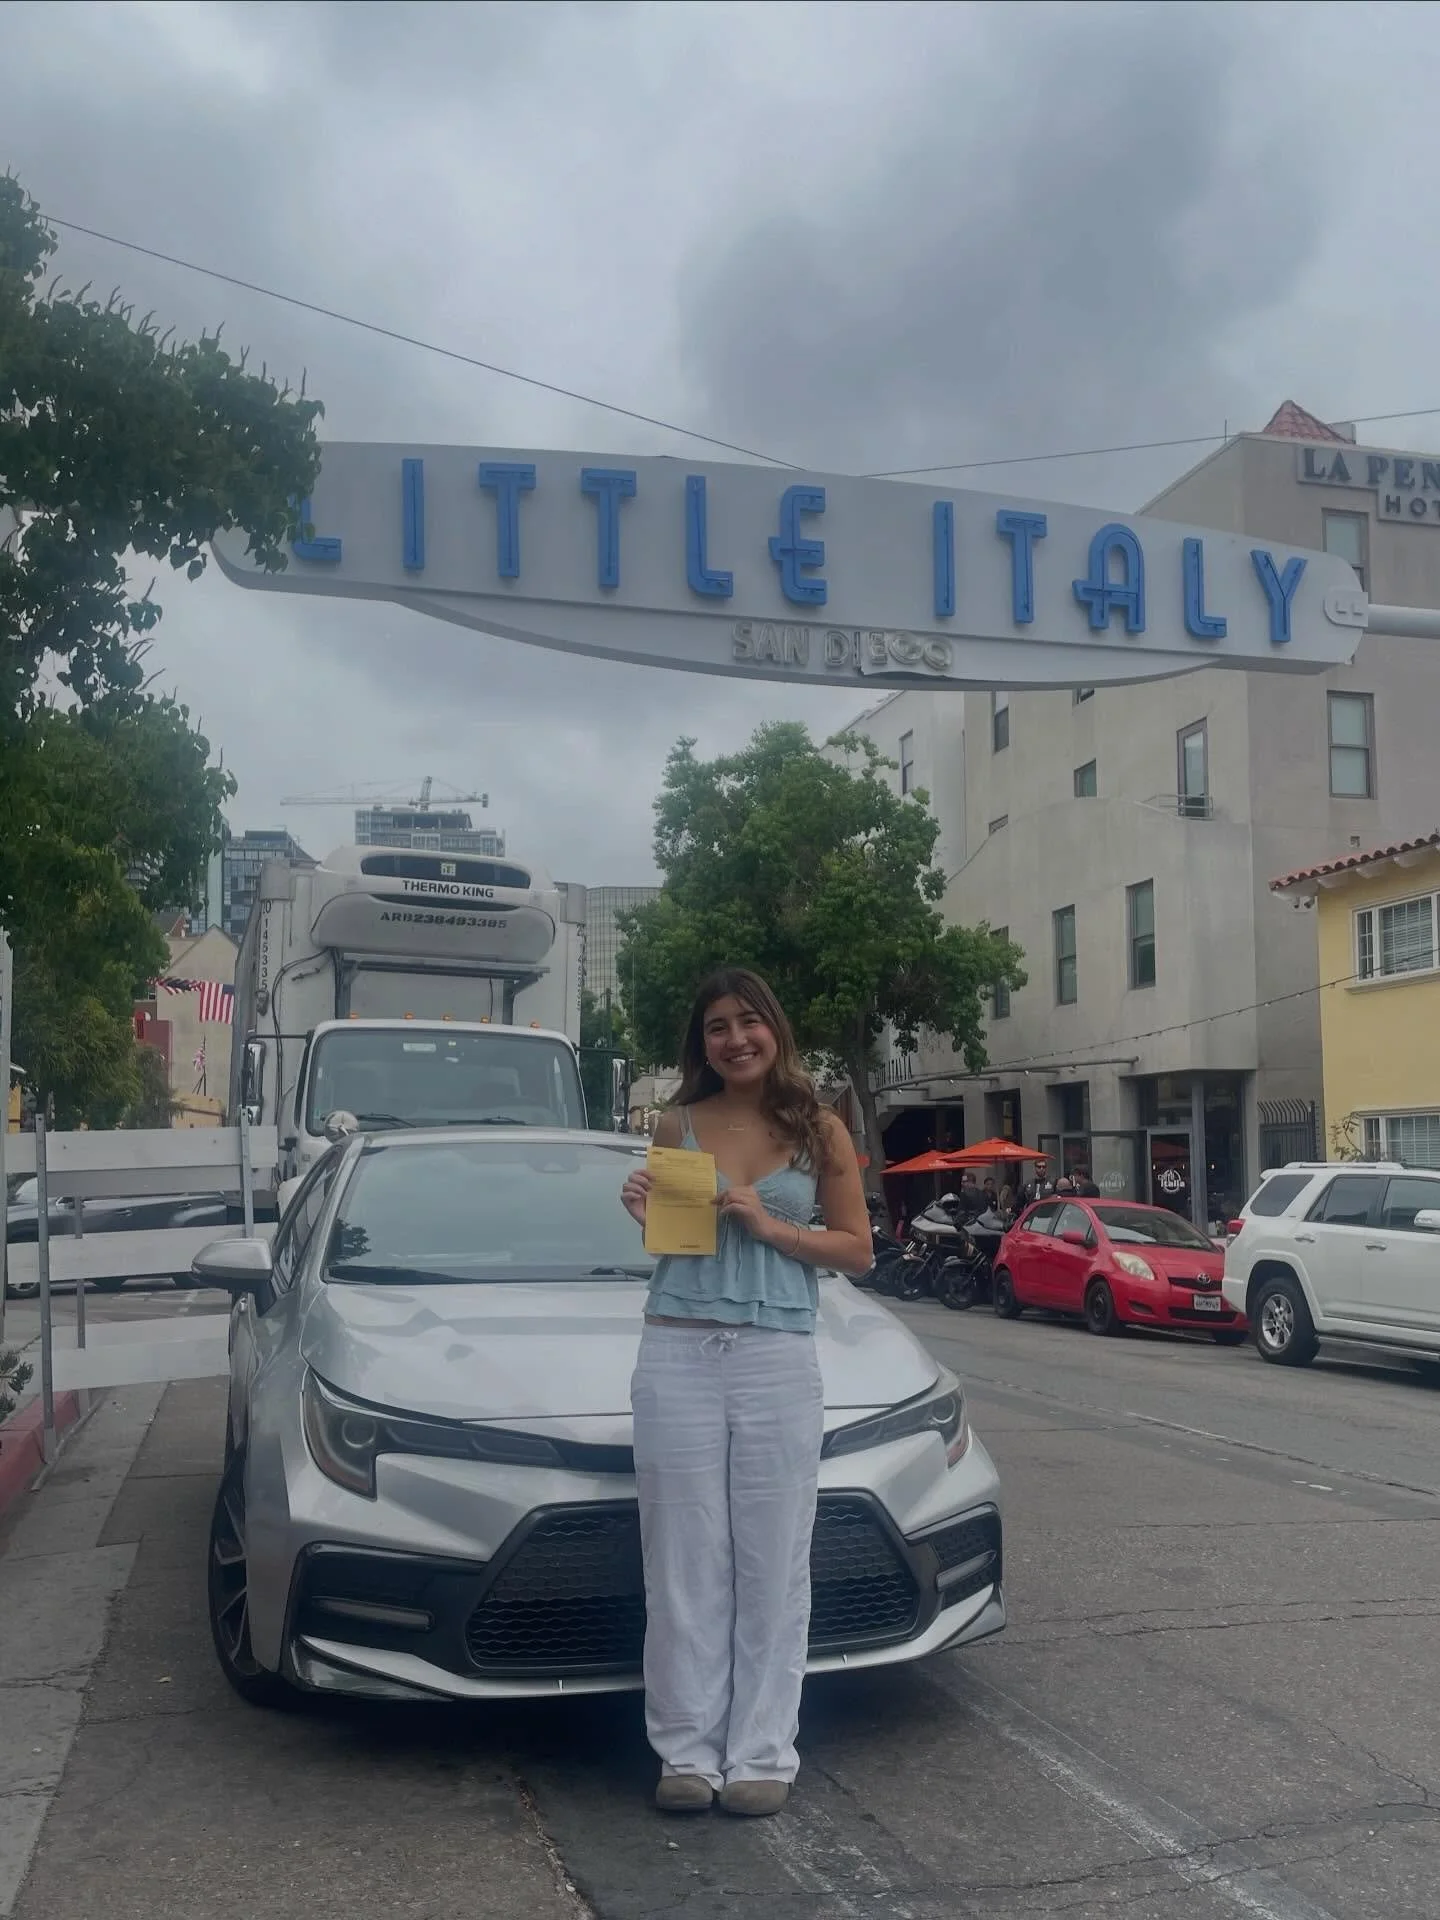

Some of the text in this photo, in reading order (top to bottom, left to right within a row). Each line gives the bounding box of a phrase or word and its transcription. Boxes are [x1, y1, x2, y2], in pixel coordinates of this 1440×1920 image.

[1303, 447, 1352, 481] LA
[933, 500, 1308, 643] ITALY
[732, 621, 953, 671] SAN DIEGO
[402, 880, 494, 899] THERMO KING
